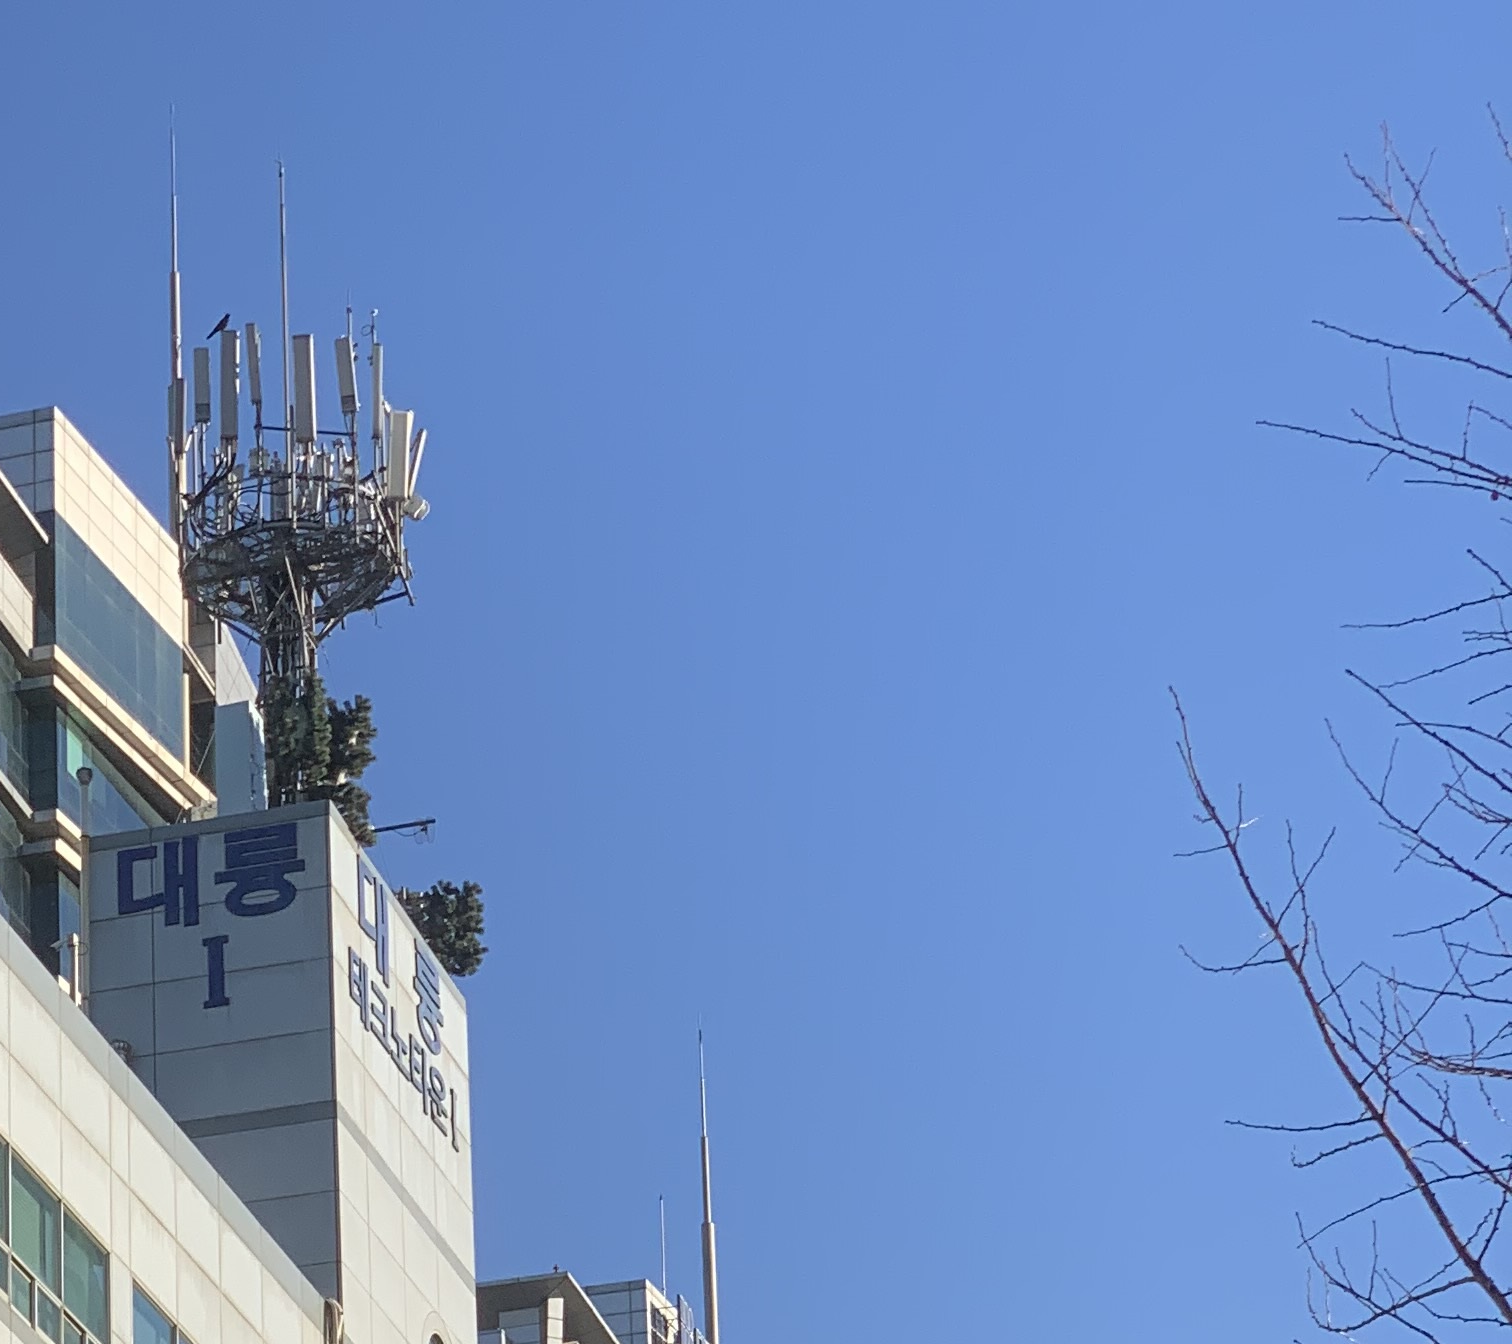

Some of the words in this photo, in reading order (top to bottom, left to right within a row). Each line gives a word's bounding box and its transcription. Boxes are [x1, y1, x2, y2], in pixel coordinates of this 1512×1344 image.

[117, 822, 306, 927] 대륭
[356, 851, 444, 1055] 대륭
[348, 946, 448, 1137] 테크노타운
